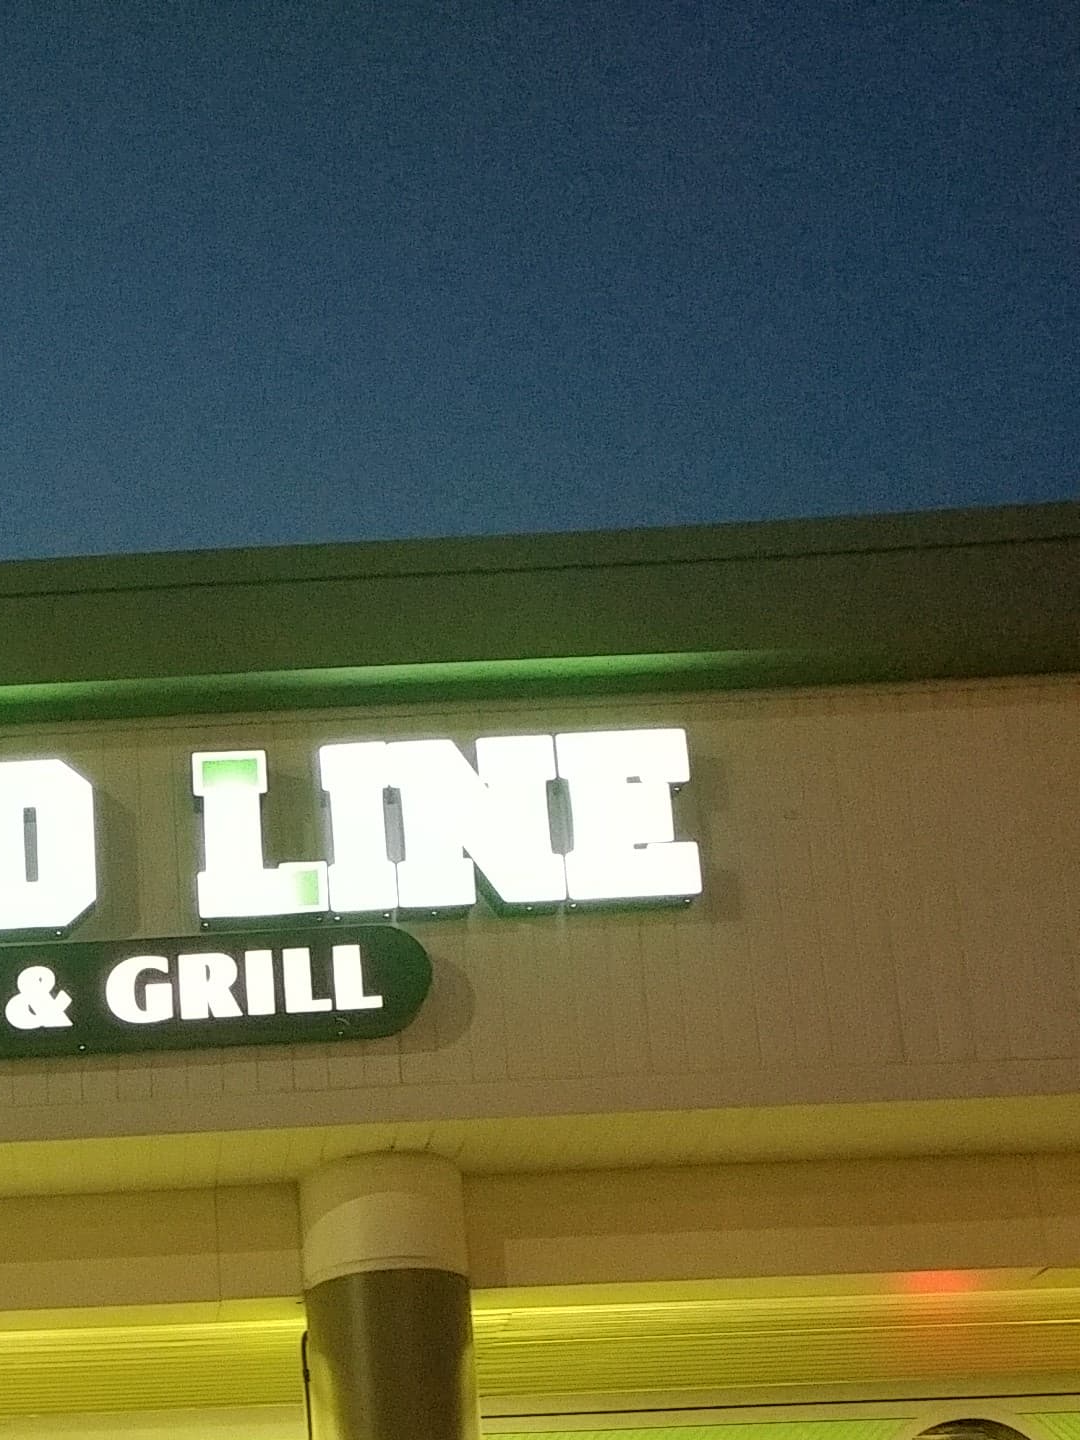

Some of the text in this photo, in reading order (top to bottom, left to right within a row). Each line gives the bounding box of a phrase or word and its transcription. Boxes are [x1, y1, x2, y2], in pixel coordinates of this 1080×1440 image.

[192, 728, 703, 918] LINE
[5, 967, 74, 1030] &
[105, 944, 383, 1025] GRILL
